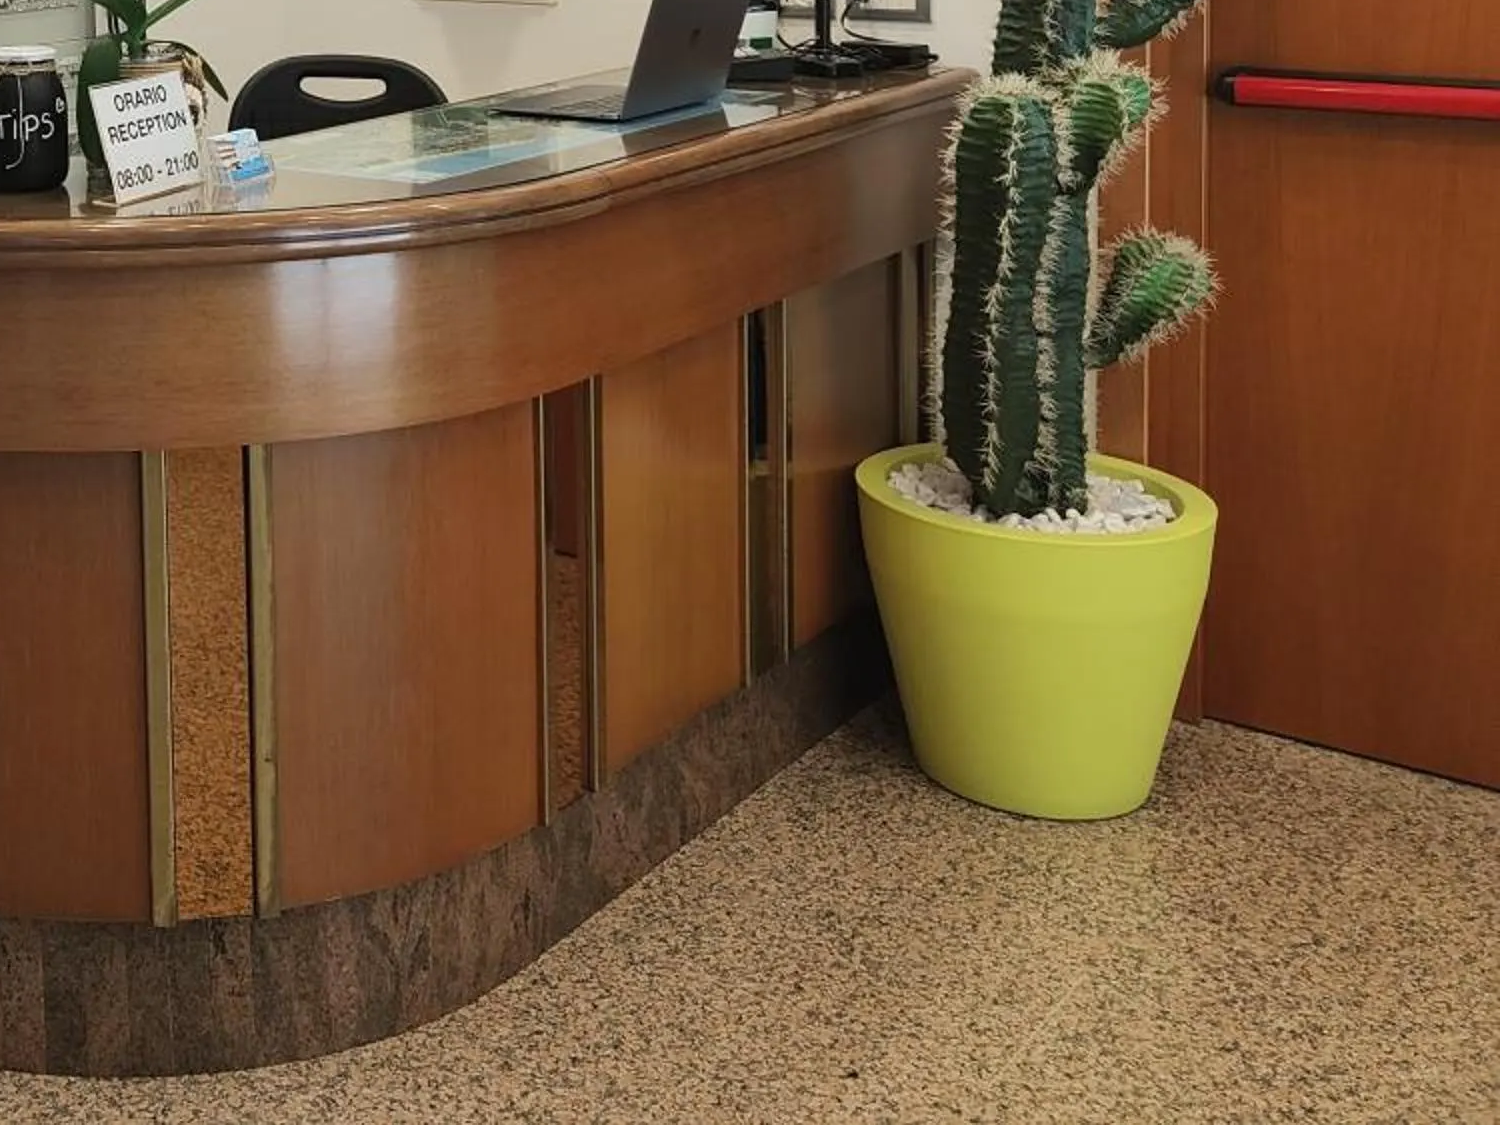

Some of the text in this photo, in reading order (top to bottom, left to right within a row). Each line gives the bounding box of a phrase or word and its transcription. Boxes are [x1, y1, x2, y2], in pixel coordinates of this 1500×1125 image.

[114, 84, 167, 112] ORARIO
[107, 111, 188, 145] RECEPTION
[116, 163, 154, 190] 08:00
[165, 150, 199, 176] 21:00
